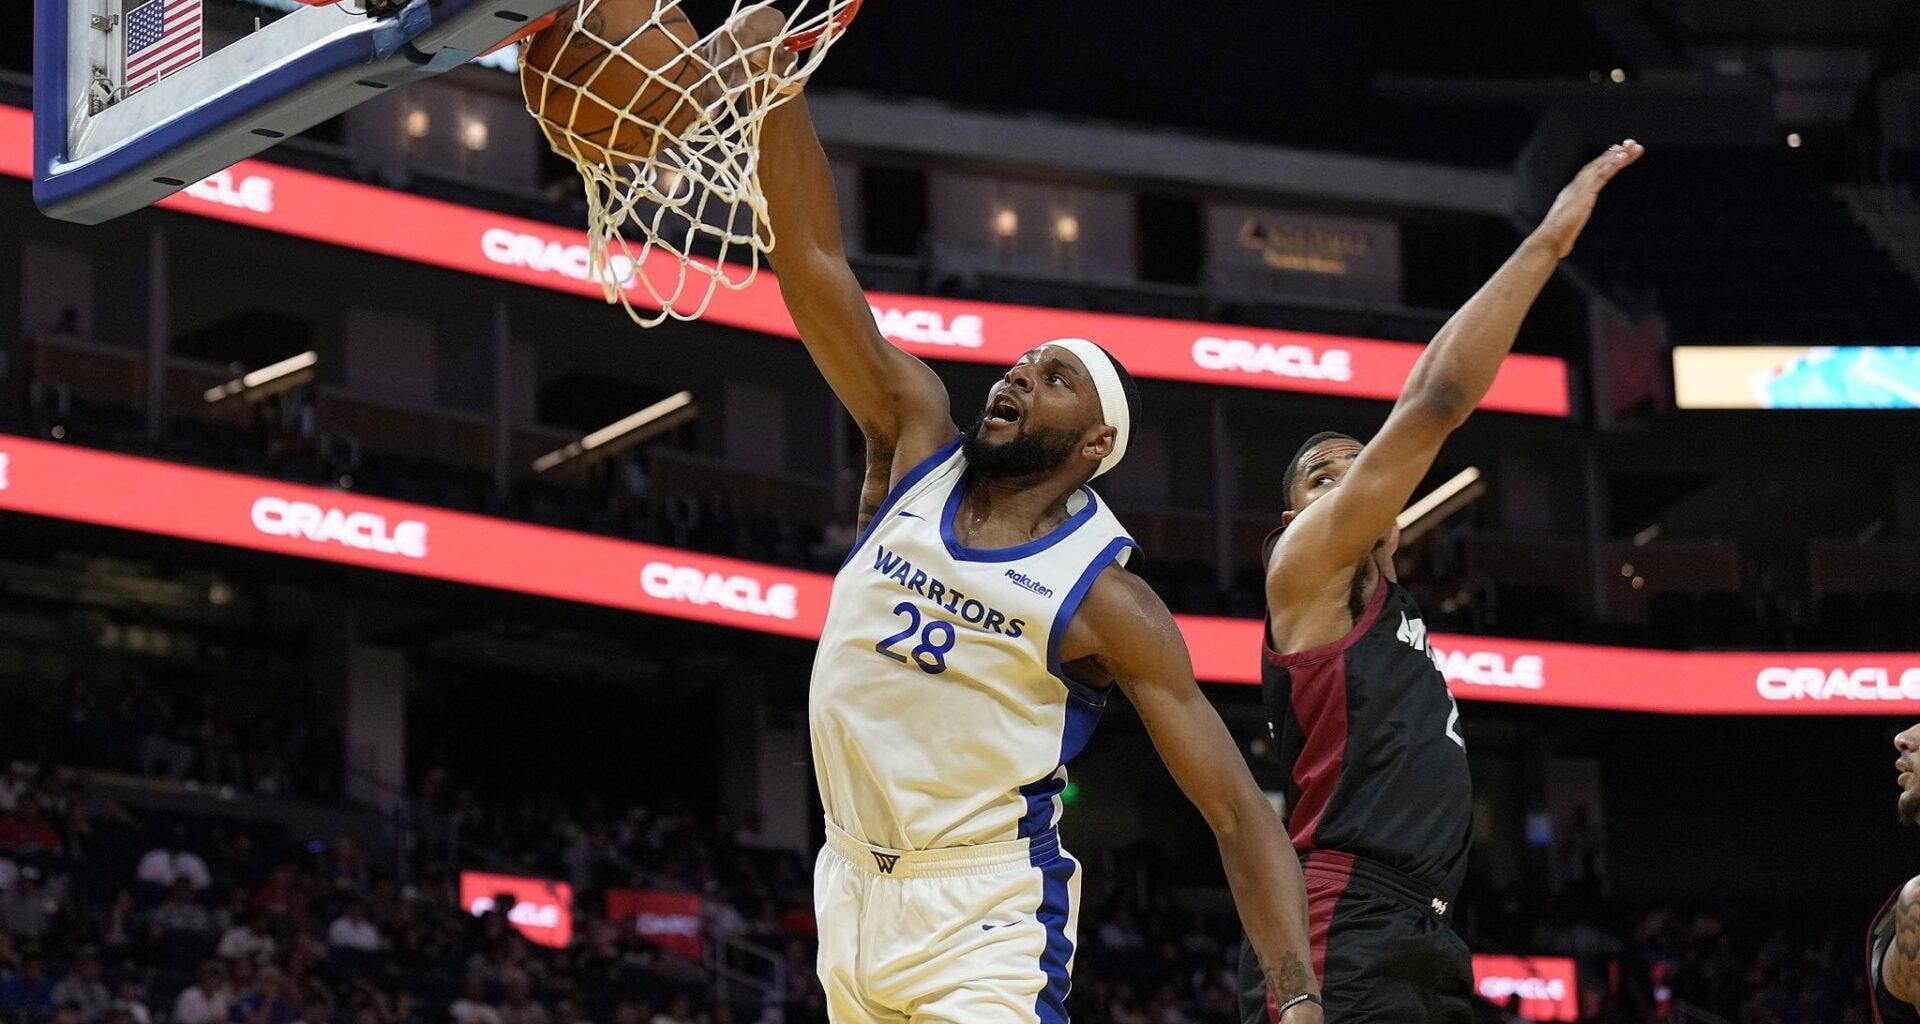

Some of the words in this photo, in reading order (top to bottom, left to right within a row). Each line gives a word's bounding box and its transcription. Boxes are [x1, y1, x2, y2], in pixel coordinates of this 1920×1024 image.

[1191, 336, 1354, 382] ORACLE
[251, 496, 428, 559] ORACLE
[640, 561, 799, 620] ORACLE
[873, 545, 1026, 639] WARRIORS
[1004, 568, 1054, 599] Rakuten
[875, 601, 956, 675] 28
